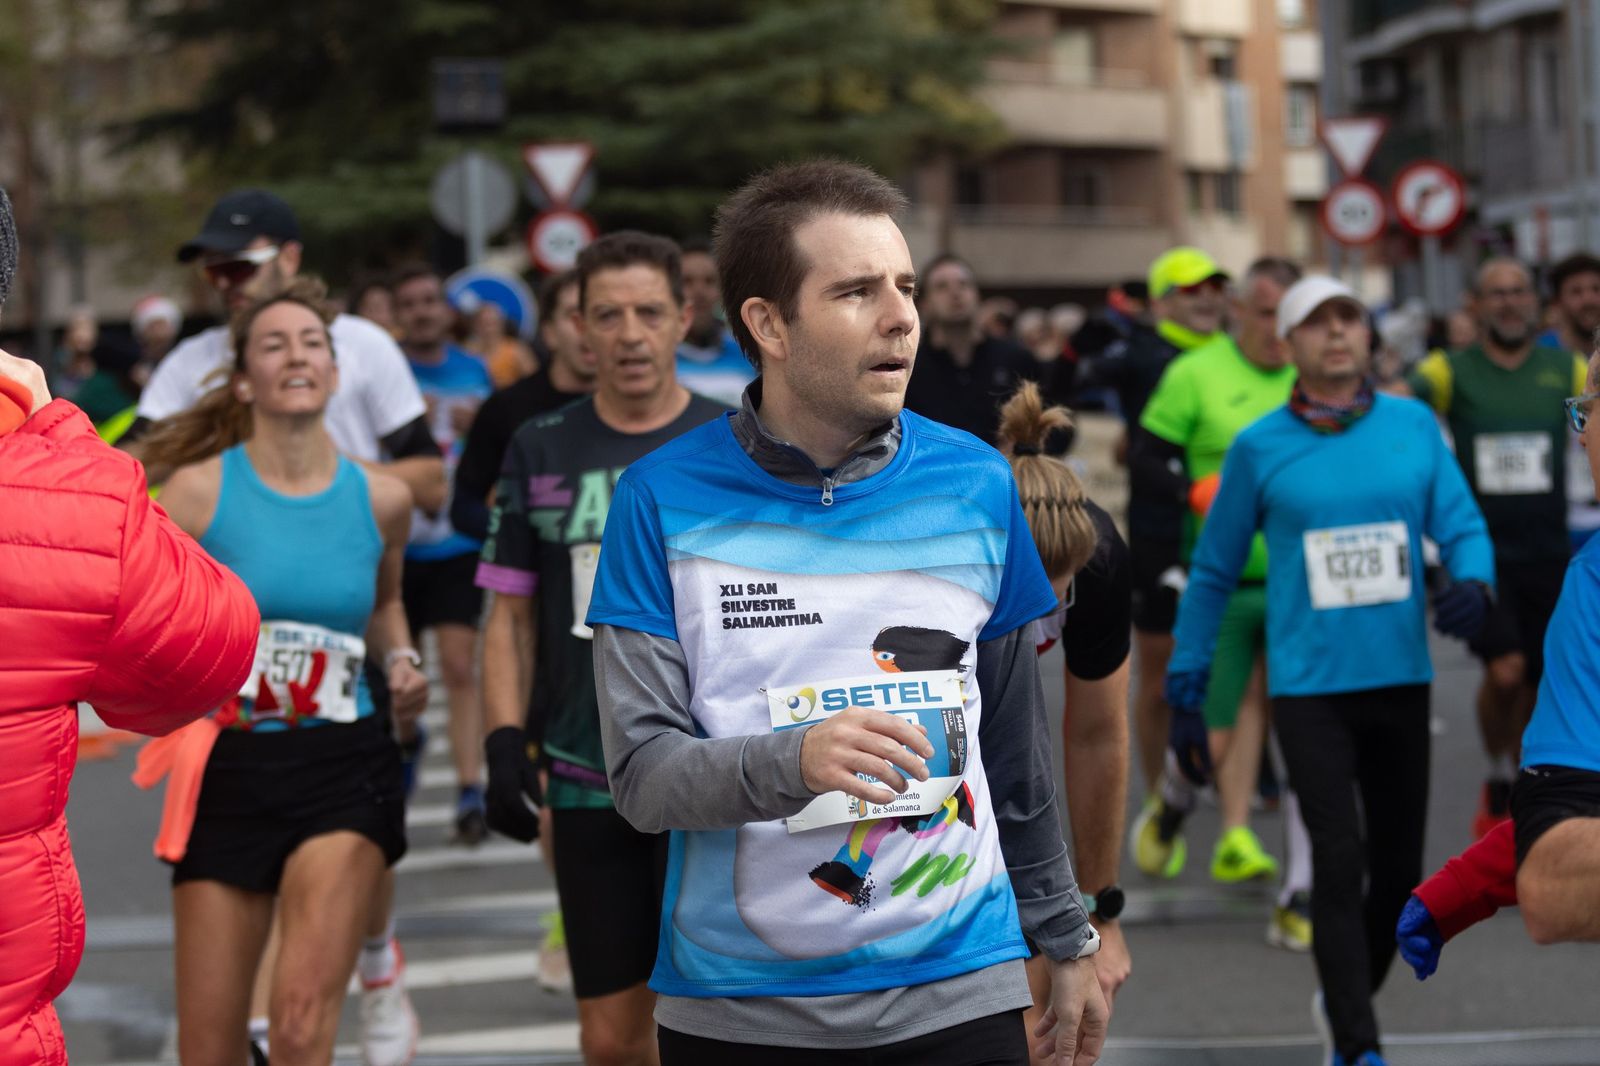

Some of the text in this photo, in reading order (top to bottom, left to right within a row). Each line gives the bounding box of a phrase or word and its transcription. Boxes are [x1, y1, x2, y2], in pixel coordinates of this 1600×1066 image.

[719, 582, 778, 597] XLI SAN
[721, 598, 796, 613] SILVESTRE
[722, 612, 823, 630] SALMANTINA
[821, 681, 942, 711] SETEL
[896, 792, 920, 800] miento
[872, 804, 921, 814] de Salamanca
